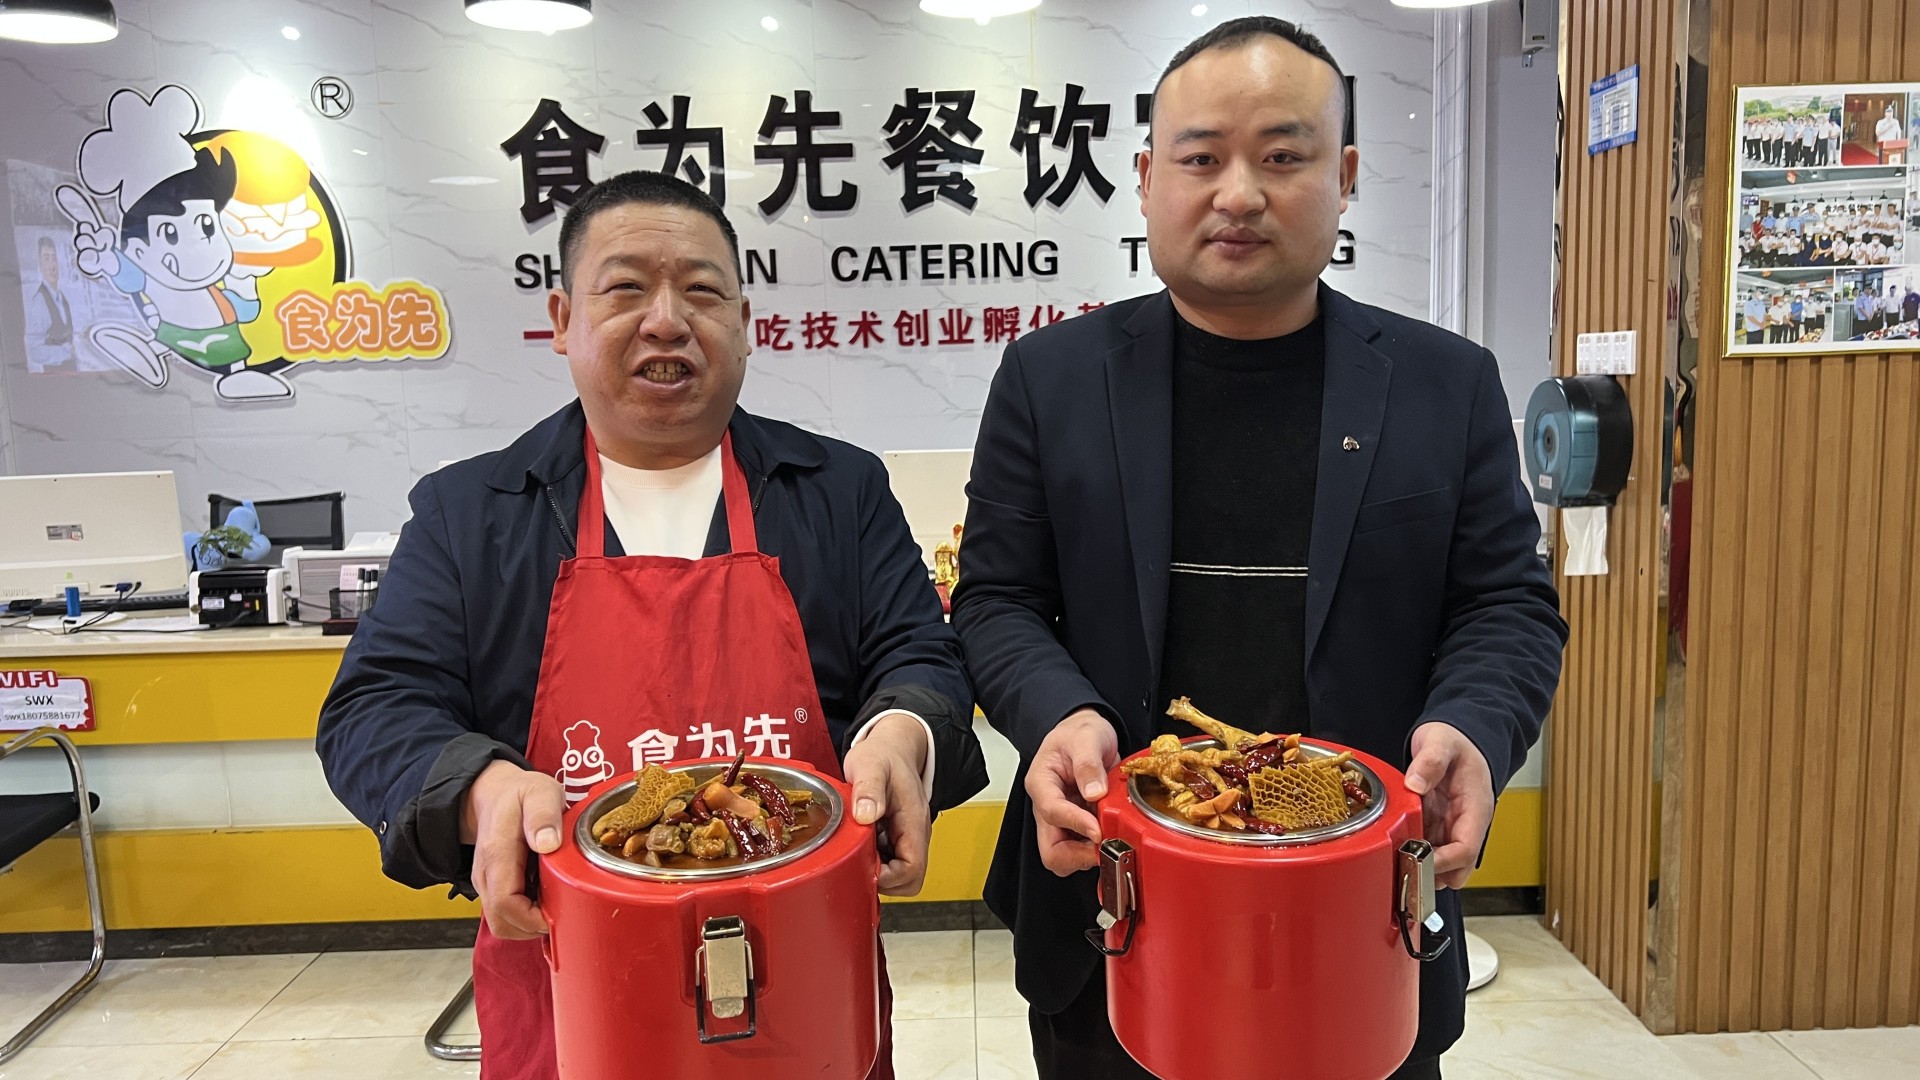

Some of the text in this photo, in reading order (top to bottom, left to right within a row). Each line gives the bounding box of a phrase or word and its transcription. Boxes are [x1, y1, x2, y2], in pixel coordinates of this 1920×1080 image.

[501, 76, 1357, 224] 食为先餐饮
[831, 239, 1058, 283] CATERING
[279, 292, 438, 348] 食为先
[25, 695, 54, 706] SWX
[627, 713, 791, 771] 食为先
